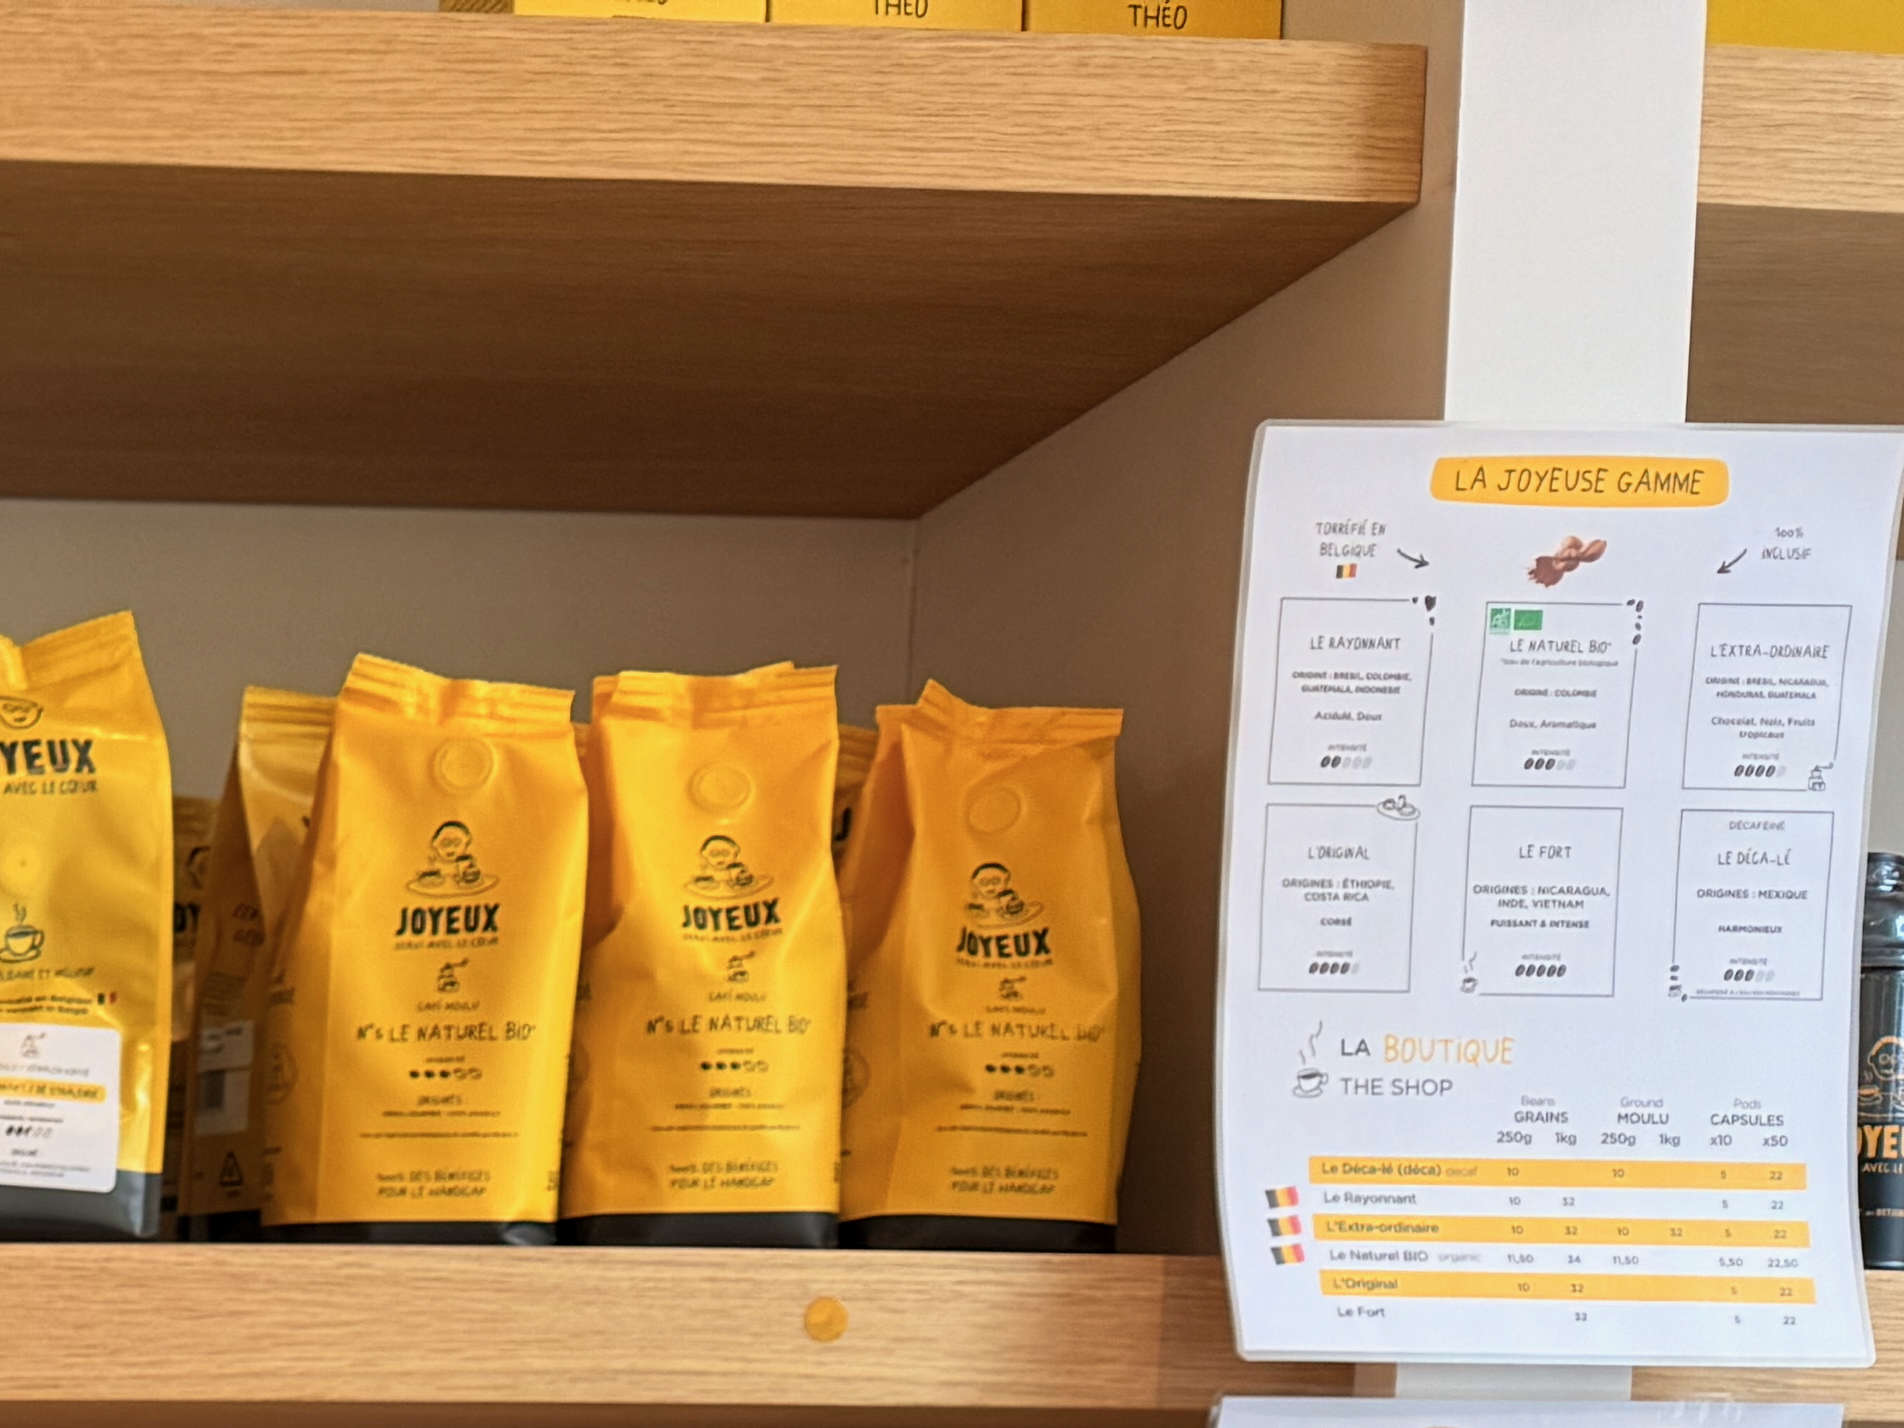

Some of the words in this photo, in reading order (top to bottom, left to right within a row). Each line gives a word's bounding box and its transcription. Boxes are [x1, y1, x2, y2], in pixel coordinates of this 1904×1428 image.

[1128, 0, 1187, 30] THÉO
[1455, 465, 1486, 491] LA
[1497, 467, 1609, 493] JOYEUSE
[1617, 468, 1704, 495] GAMME
[1310, 635, 1324, 650] LE
[1329, 636, 1401, 650] RAYONNANT
[1510, 638, 1524, 653] LE
[1528, 639, 1583, 653] NATUREL
[1519, 844, 1535, 859] LE
[1539, 845, 1571, 859] FORT
[1718, 851, 1732, 865] LE
[395, 903, 500, 936] JOYEUX
[682, 898, 781, 934] JOYEUX
[388, 1024, 411, 1043] LE
[417, 1021, 497, 1041] NATUREL
[1341, 1038, 1371, 1056] LA
[1340, 1077, 1384, 1096] THE
[1391, 1078, 1453, 1096] SHOP
[1514, 1111, 1568, 1124] GRAINS
[1617, 1112, 1669, 1125] MOULU
[1710, 1113, 1784, 1127] CAPSULES
[1497, 1131, 1532, 1145] 250g
[1555, 1132, 1577, 1146] 1kg
[1601, 1132, 1636, 1147] 250g
[1659, 1133, 1680, 1147] 1kg
[1710, 1134, 1732, 1146] x10
[1763, 1135, 1788, 1147] x50
